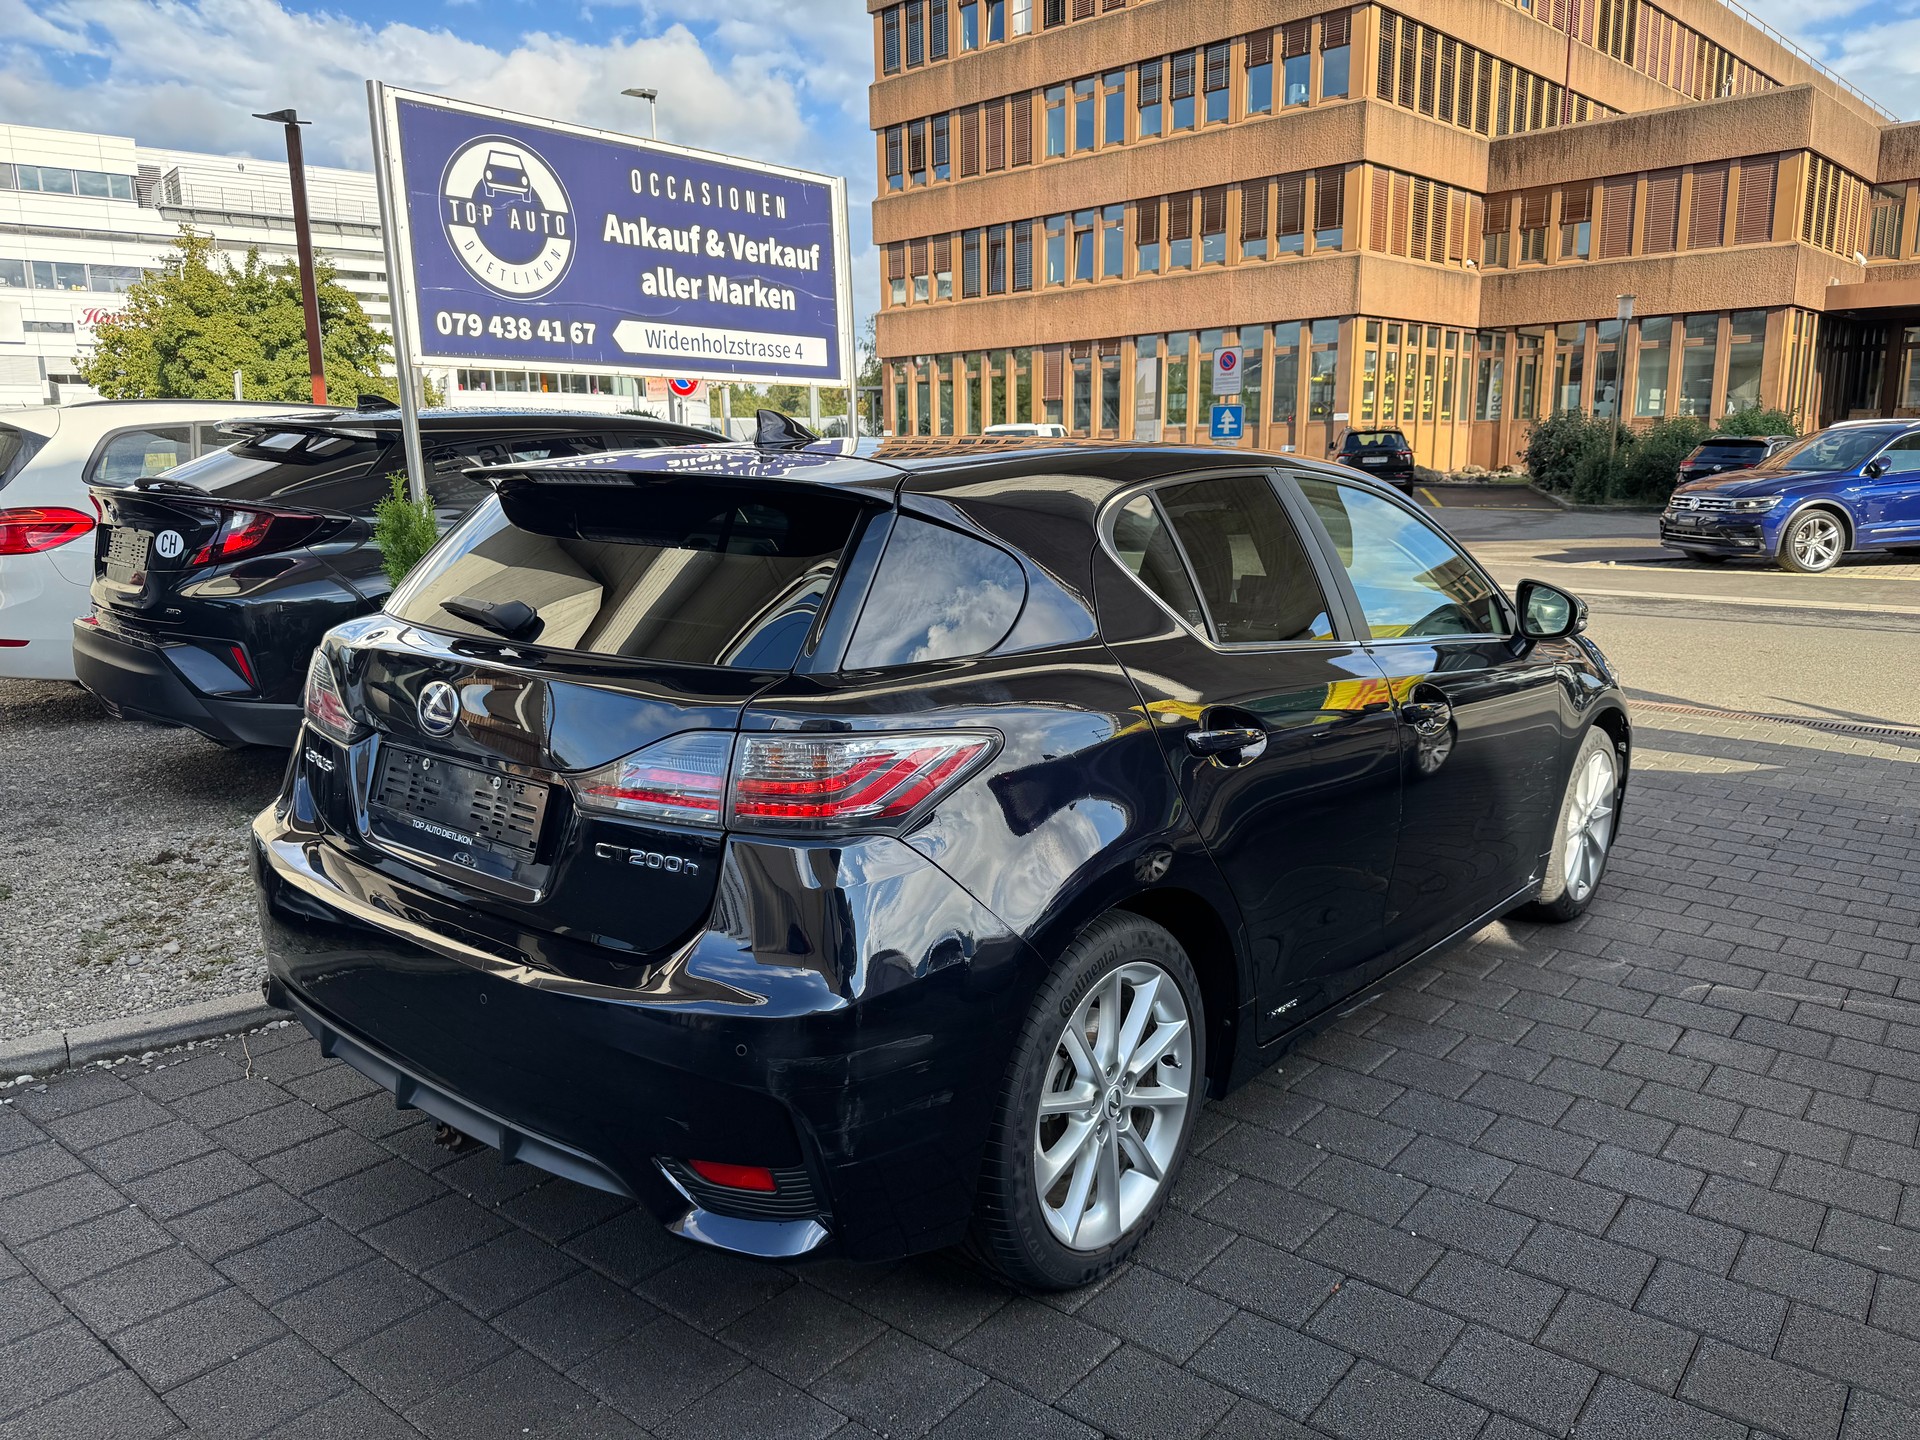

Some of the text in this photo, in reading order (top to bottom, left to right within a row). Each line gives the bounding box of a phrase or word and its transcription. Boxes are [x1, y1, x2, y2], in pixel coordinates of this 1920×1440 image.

[630, 169, 787, 219] OCCASIONEN
[449, 199, 566, 236] TOP AUTO
[464, 240, 562, 285] DIETLIKON
[603, 213, 820, 271] Ankauf & Verkauf
[641, 266, 796, 311] aller Marken
[436, 311, 596, 345] 079 438 41 67
[644, 328, 804, 360] Widenholzstrasse 4
[161, 533, 178, 554] CH
[412, 819, 474, 846] TOP AUTO DIETLIKON
[1059, 944, 1119, 1018] Continental
